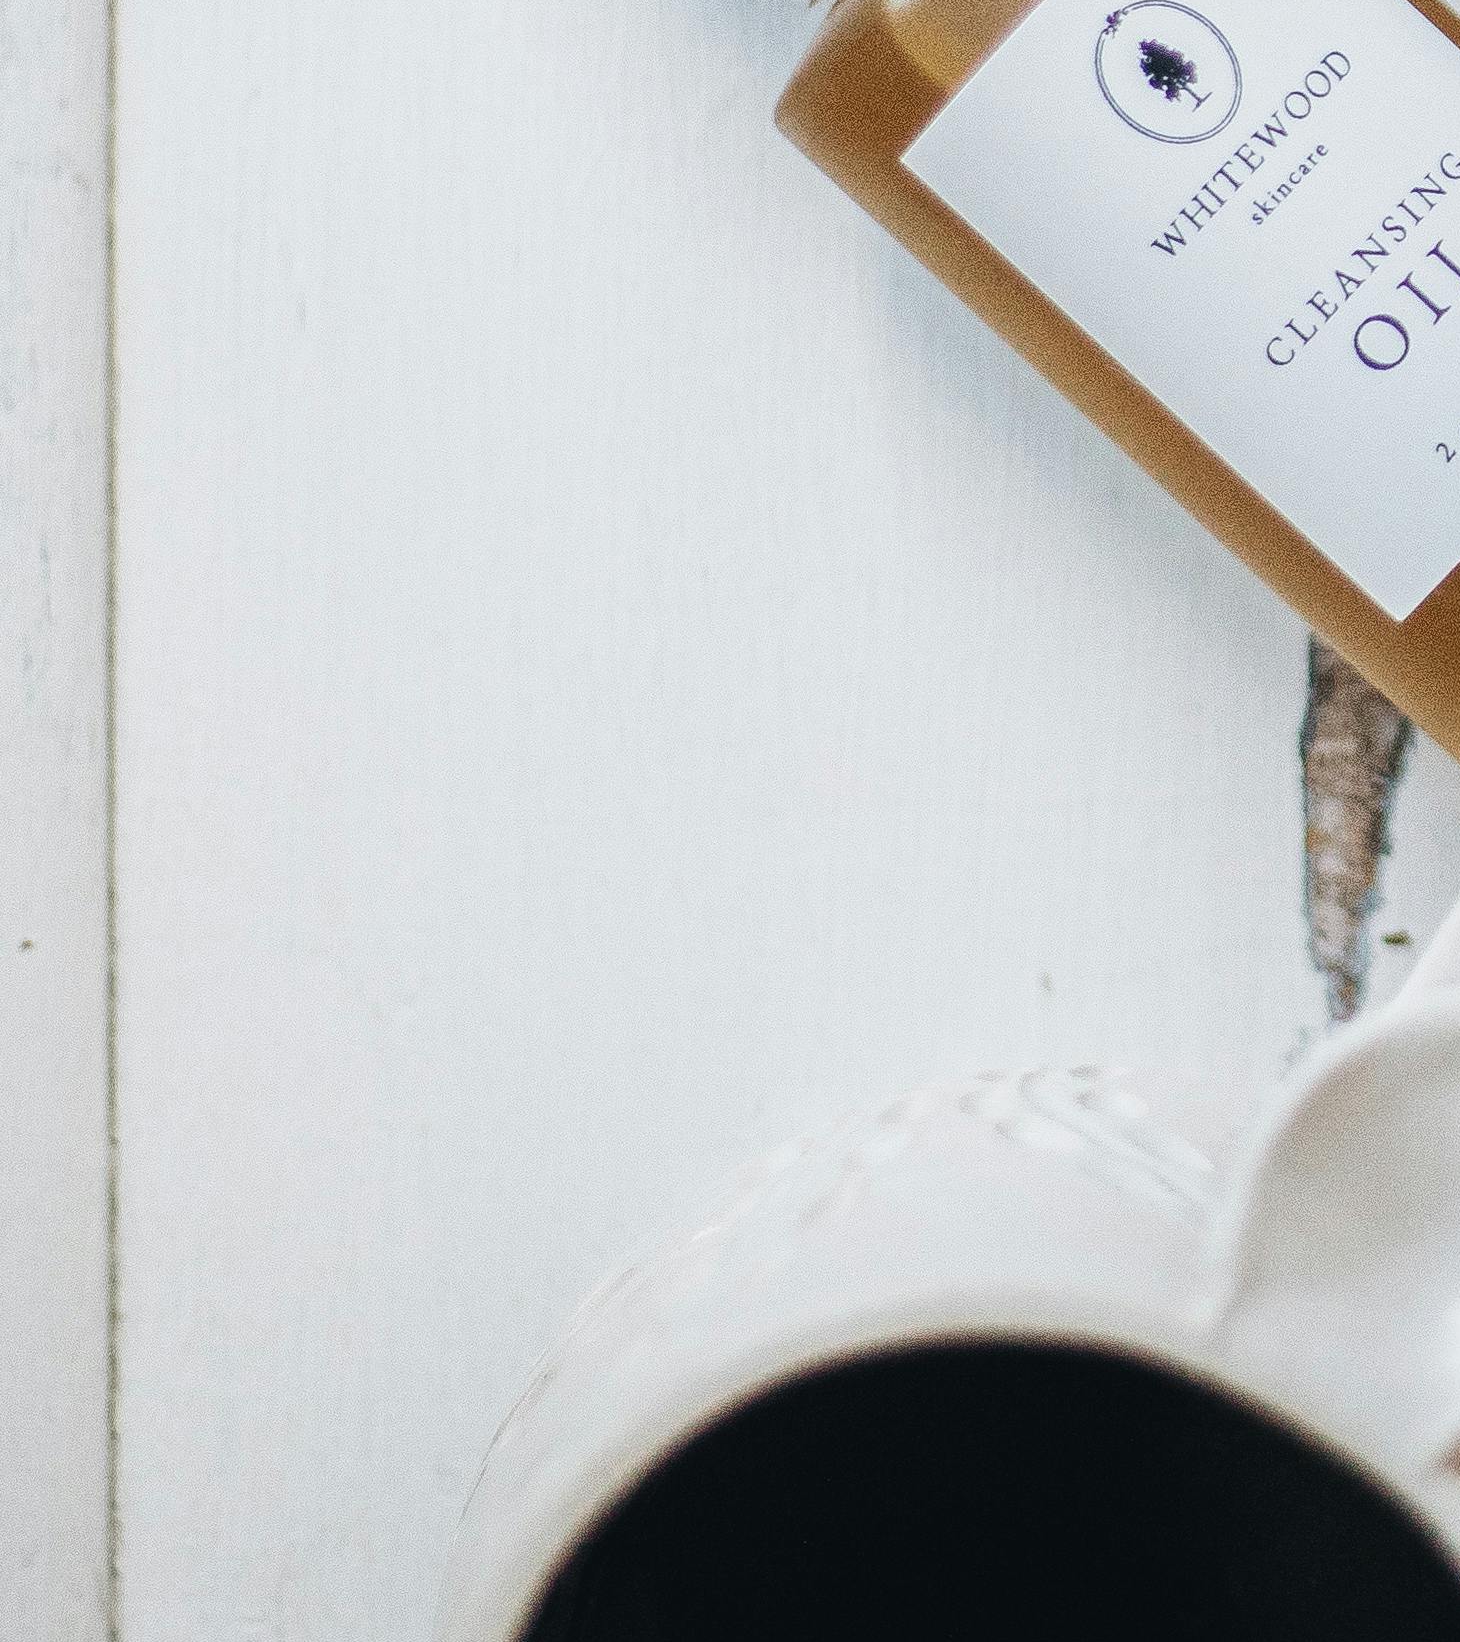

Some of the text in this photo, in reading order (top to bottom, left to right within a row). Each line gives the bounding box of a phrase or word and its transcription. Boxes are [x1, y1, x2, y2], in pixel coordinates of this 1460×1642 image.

[1149, 49, 1351, 257] WHITEWOOD
[1250, 143, 1328, 226] skincare
[1434, 441, 1457, 464] 2
